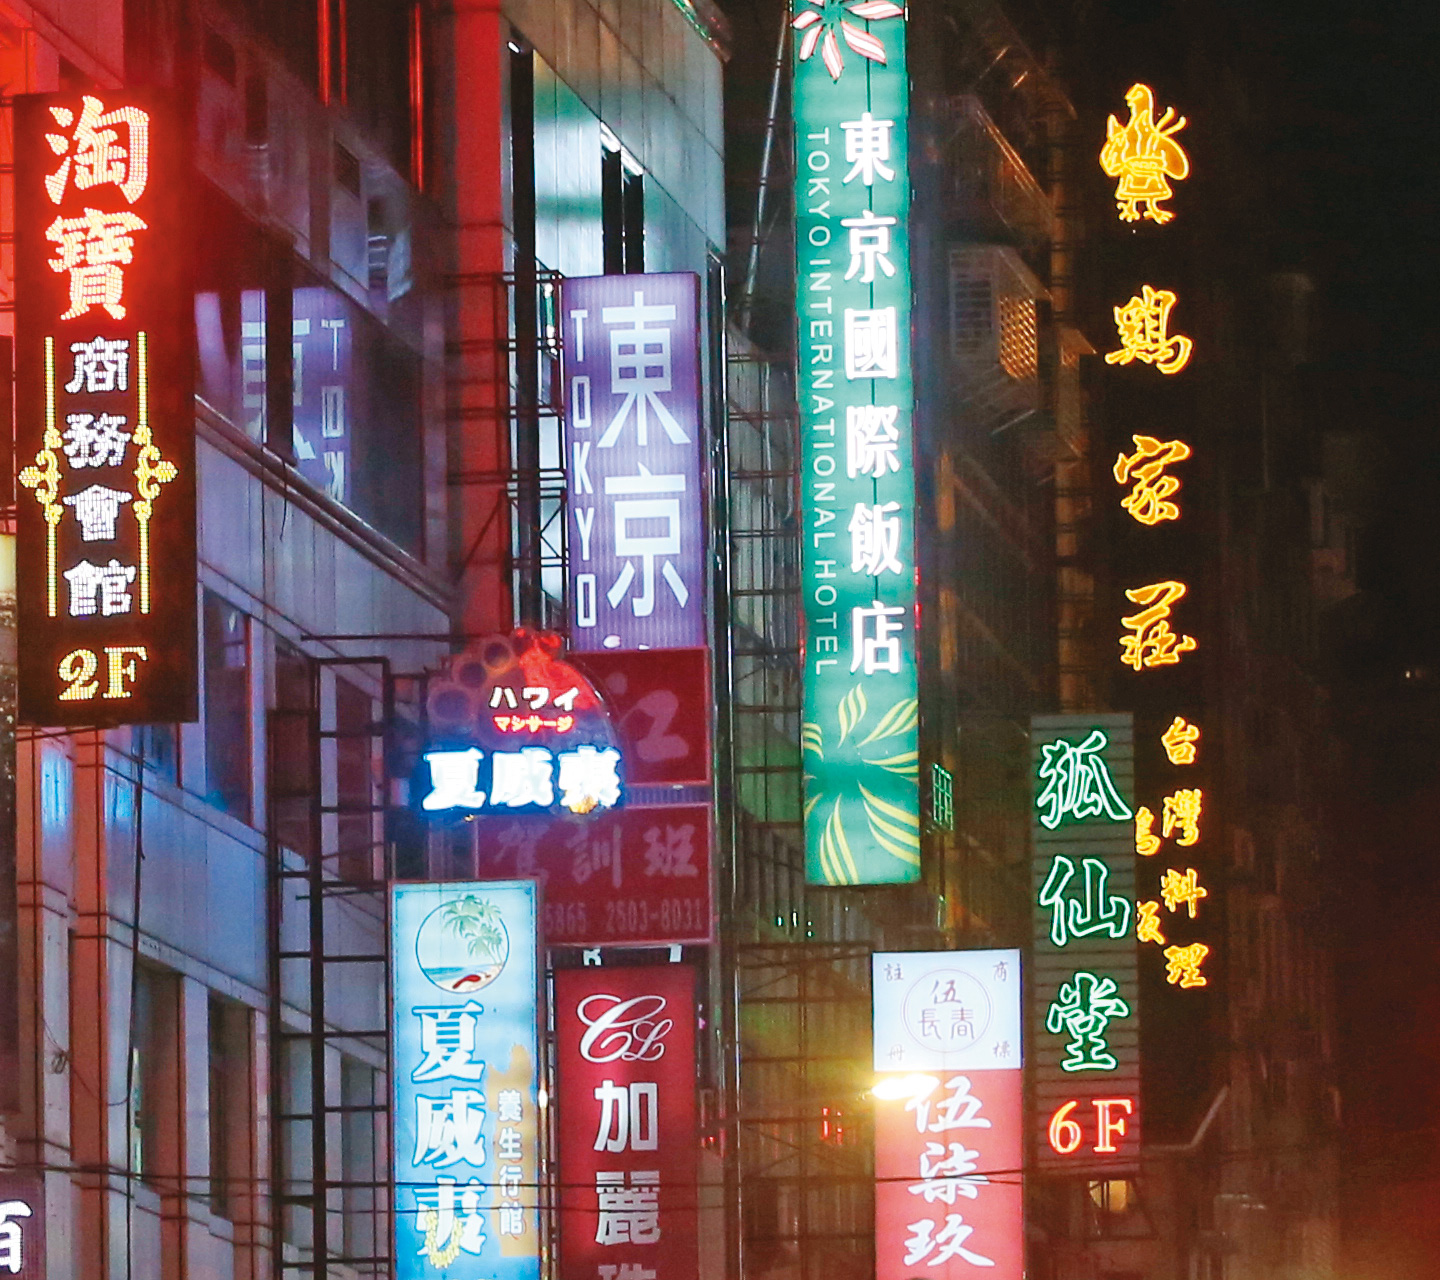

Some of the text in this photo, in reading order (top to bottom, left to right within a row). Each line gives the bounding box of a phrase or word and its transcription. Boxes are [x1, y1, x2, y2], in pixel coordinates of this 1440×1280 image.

[44, 95, 150, 321] 淘寶
[62, 337, 134, 618] 商務會館
[569, 309, 598, 628] TOKYO
[597, 291, 690, 617] 東京
[807, 130, 841, 676] TOKYO INTERNATIONAL HOTEL
[840, 111, 906, 676] 東京國際飯店
[58, 647, 148, 702] 2F
[489, 686, 579, 711] ハワイ
[1036, 730, 1133, 1072] 狐仙堂
[412, 1002, 487, 1260] 夏威夷
[1048, 1097, 1134, 1155] 6F
